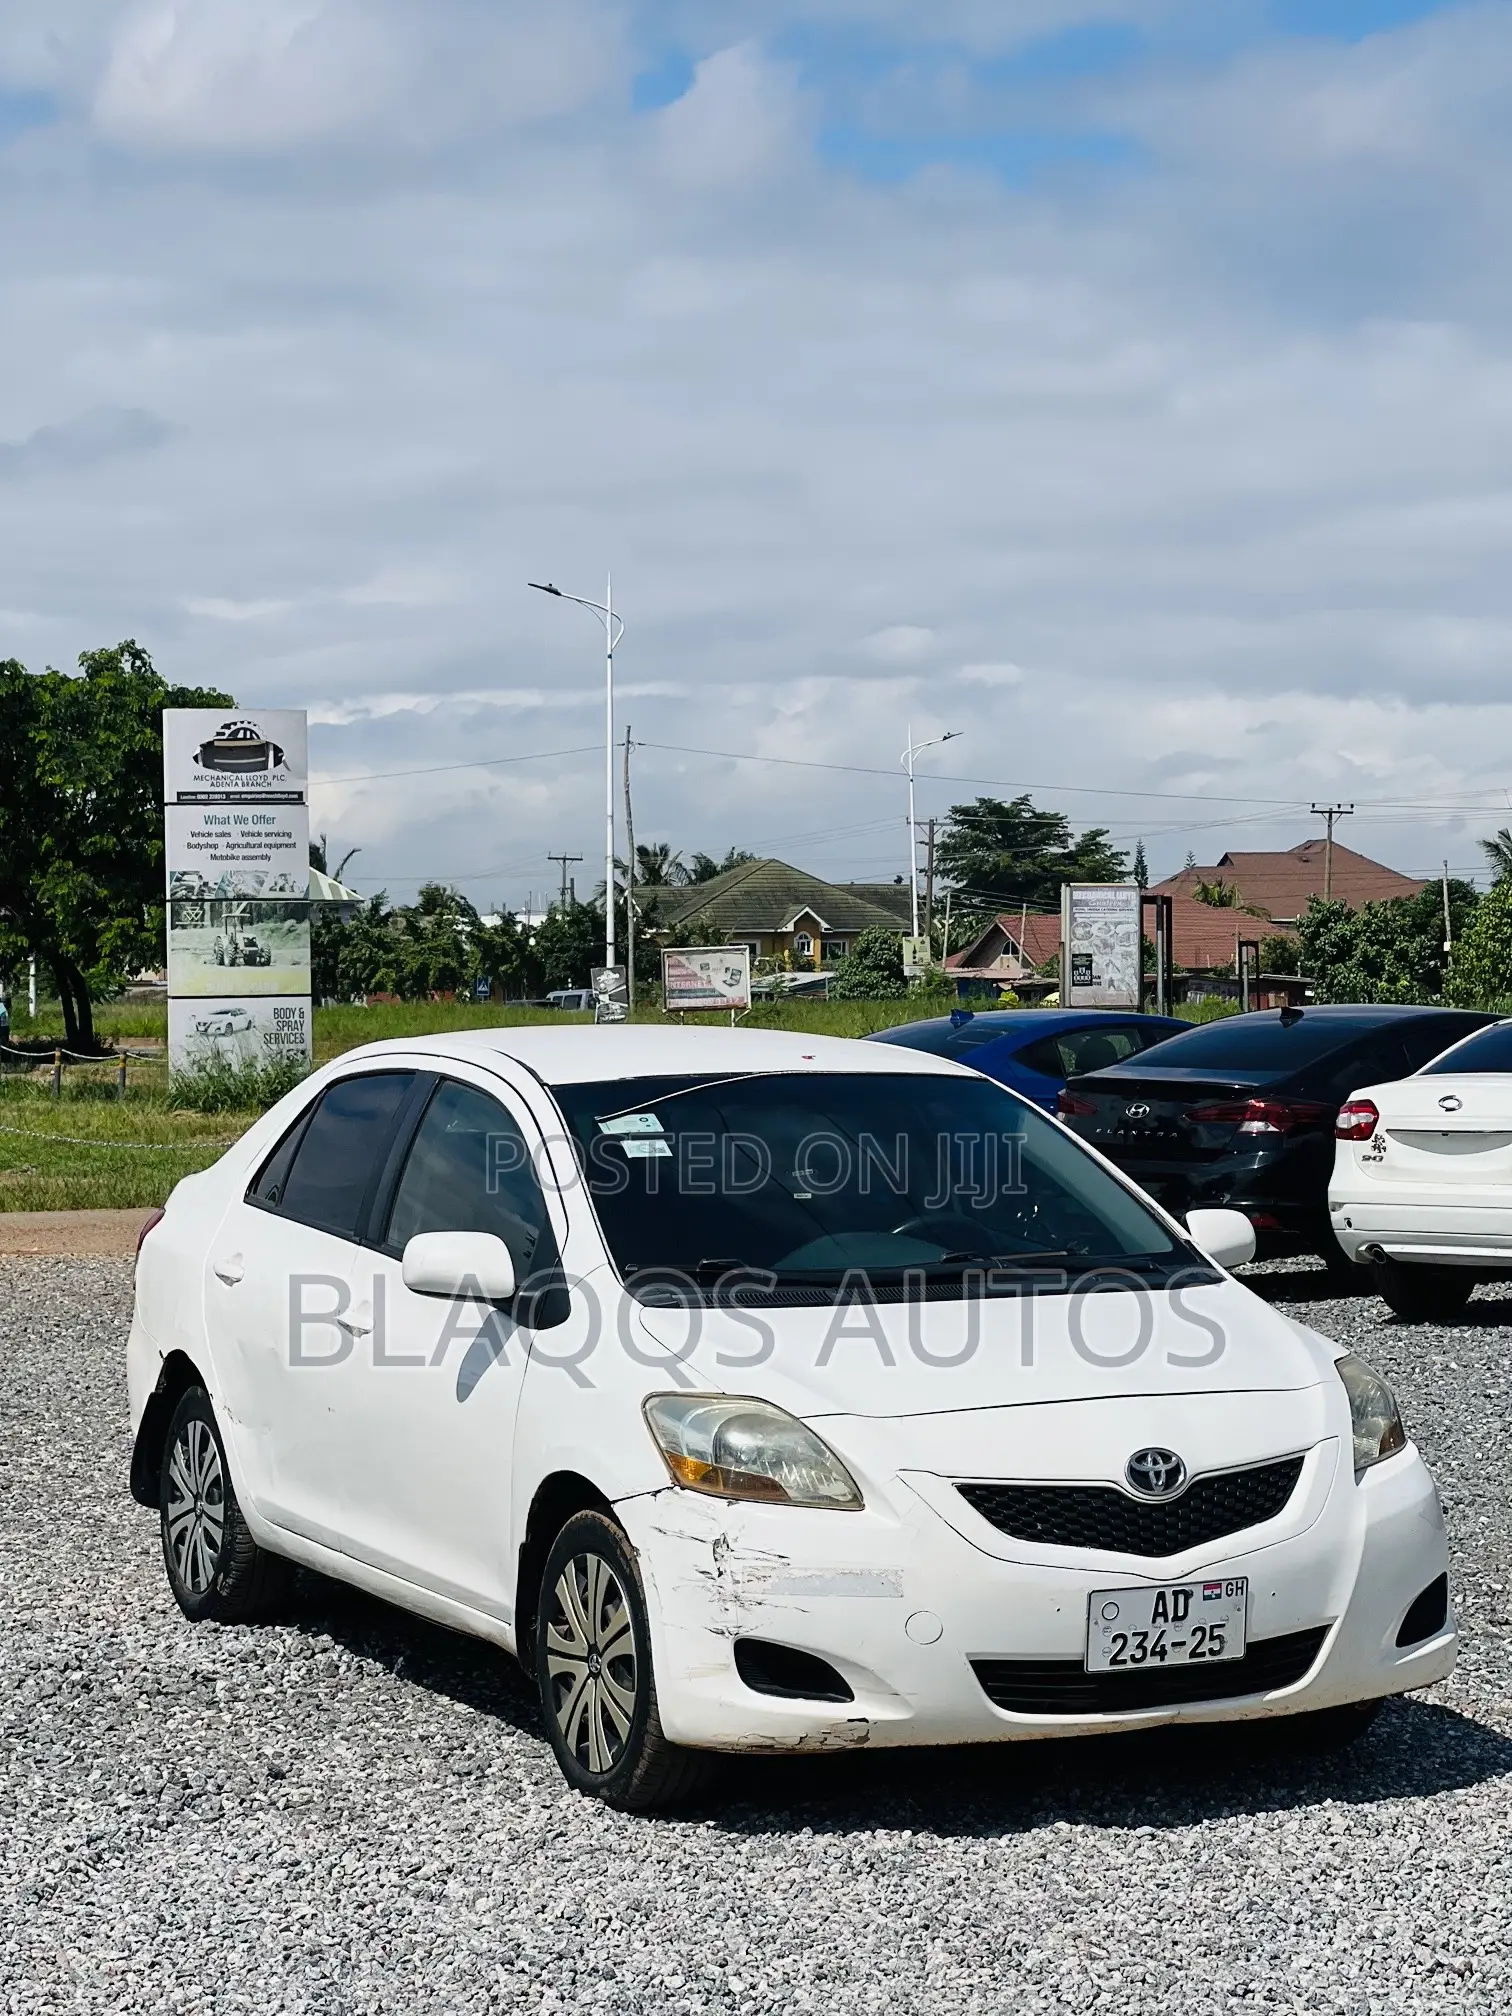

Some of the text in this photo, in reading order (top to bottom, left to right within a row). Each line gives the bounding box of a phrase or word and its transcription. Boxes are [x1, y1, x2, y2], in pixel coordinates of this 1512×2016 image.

[203, 814, 276, 825] What We Offer
[190, 830, 214, 838] Vehicle
[240, 830, 293, 840] Vehicle servicing
[186, 842, 219, 851] Bodyshop
[225, 841, 297, 850] Agricultural equipment
[210, 853, 272, 862] Motobike assembly
[273, 1007, 305, 1019] BODY &
[276, 1020, 305, 1032] SPRAY
[263, 1032, 305, 1045] SERVICES
[1225, 1580, 1244, 1598] GH
[1151, 1589, 1190, 1624] AD
[1109, 1623, 1227, 1666] 234-25
